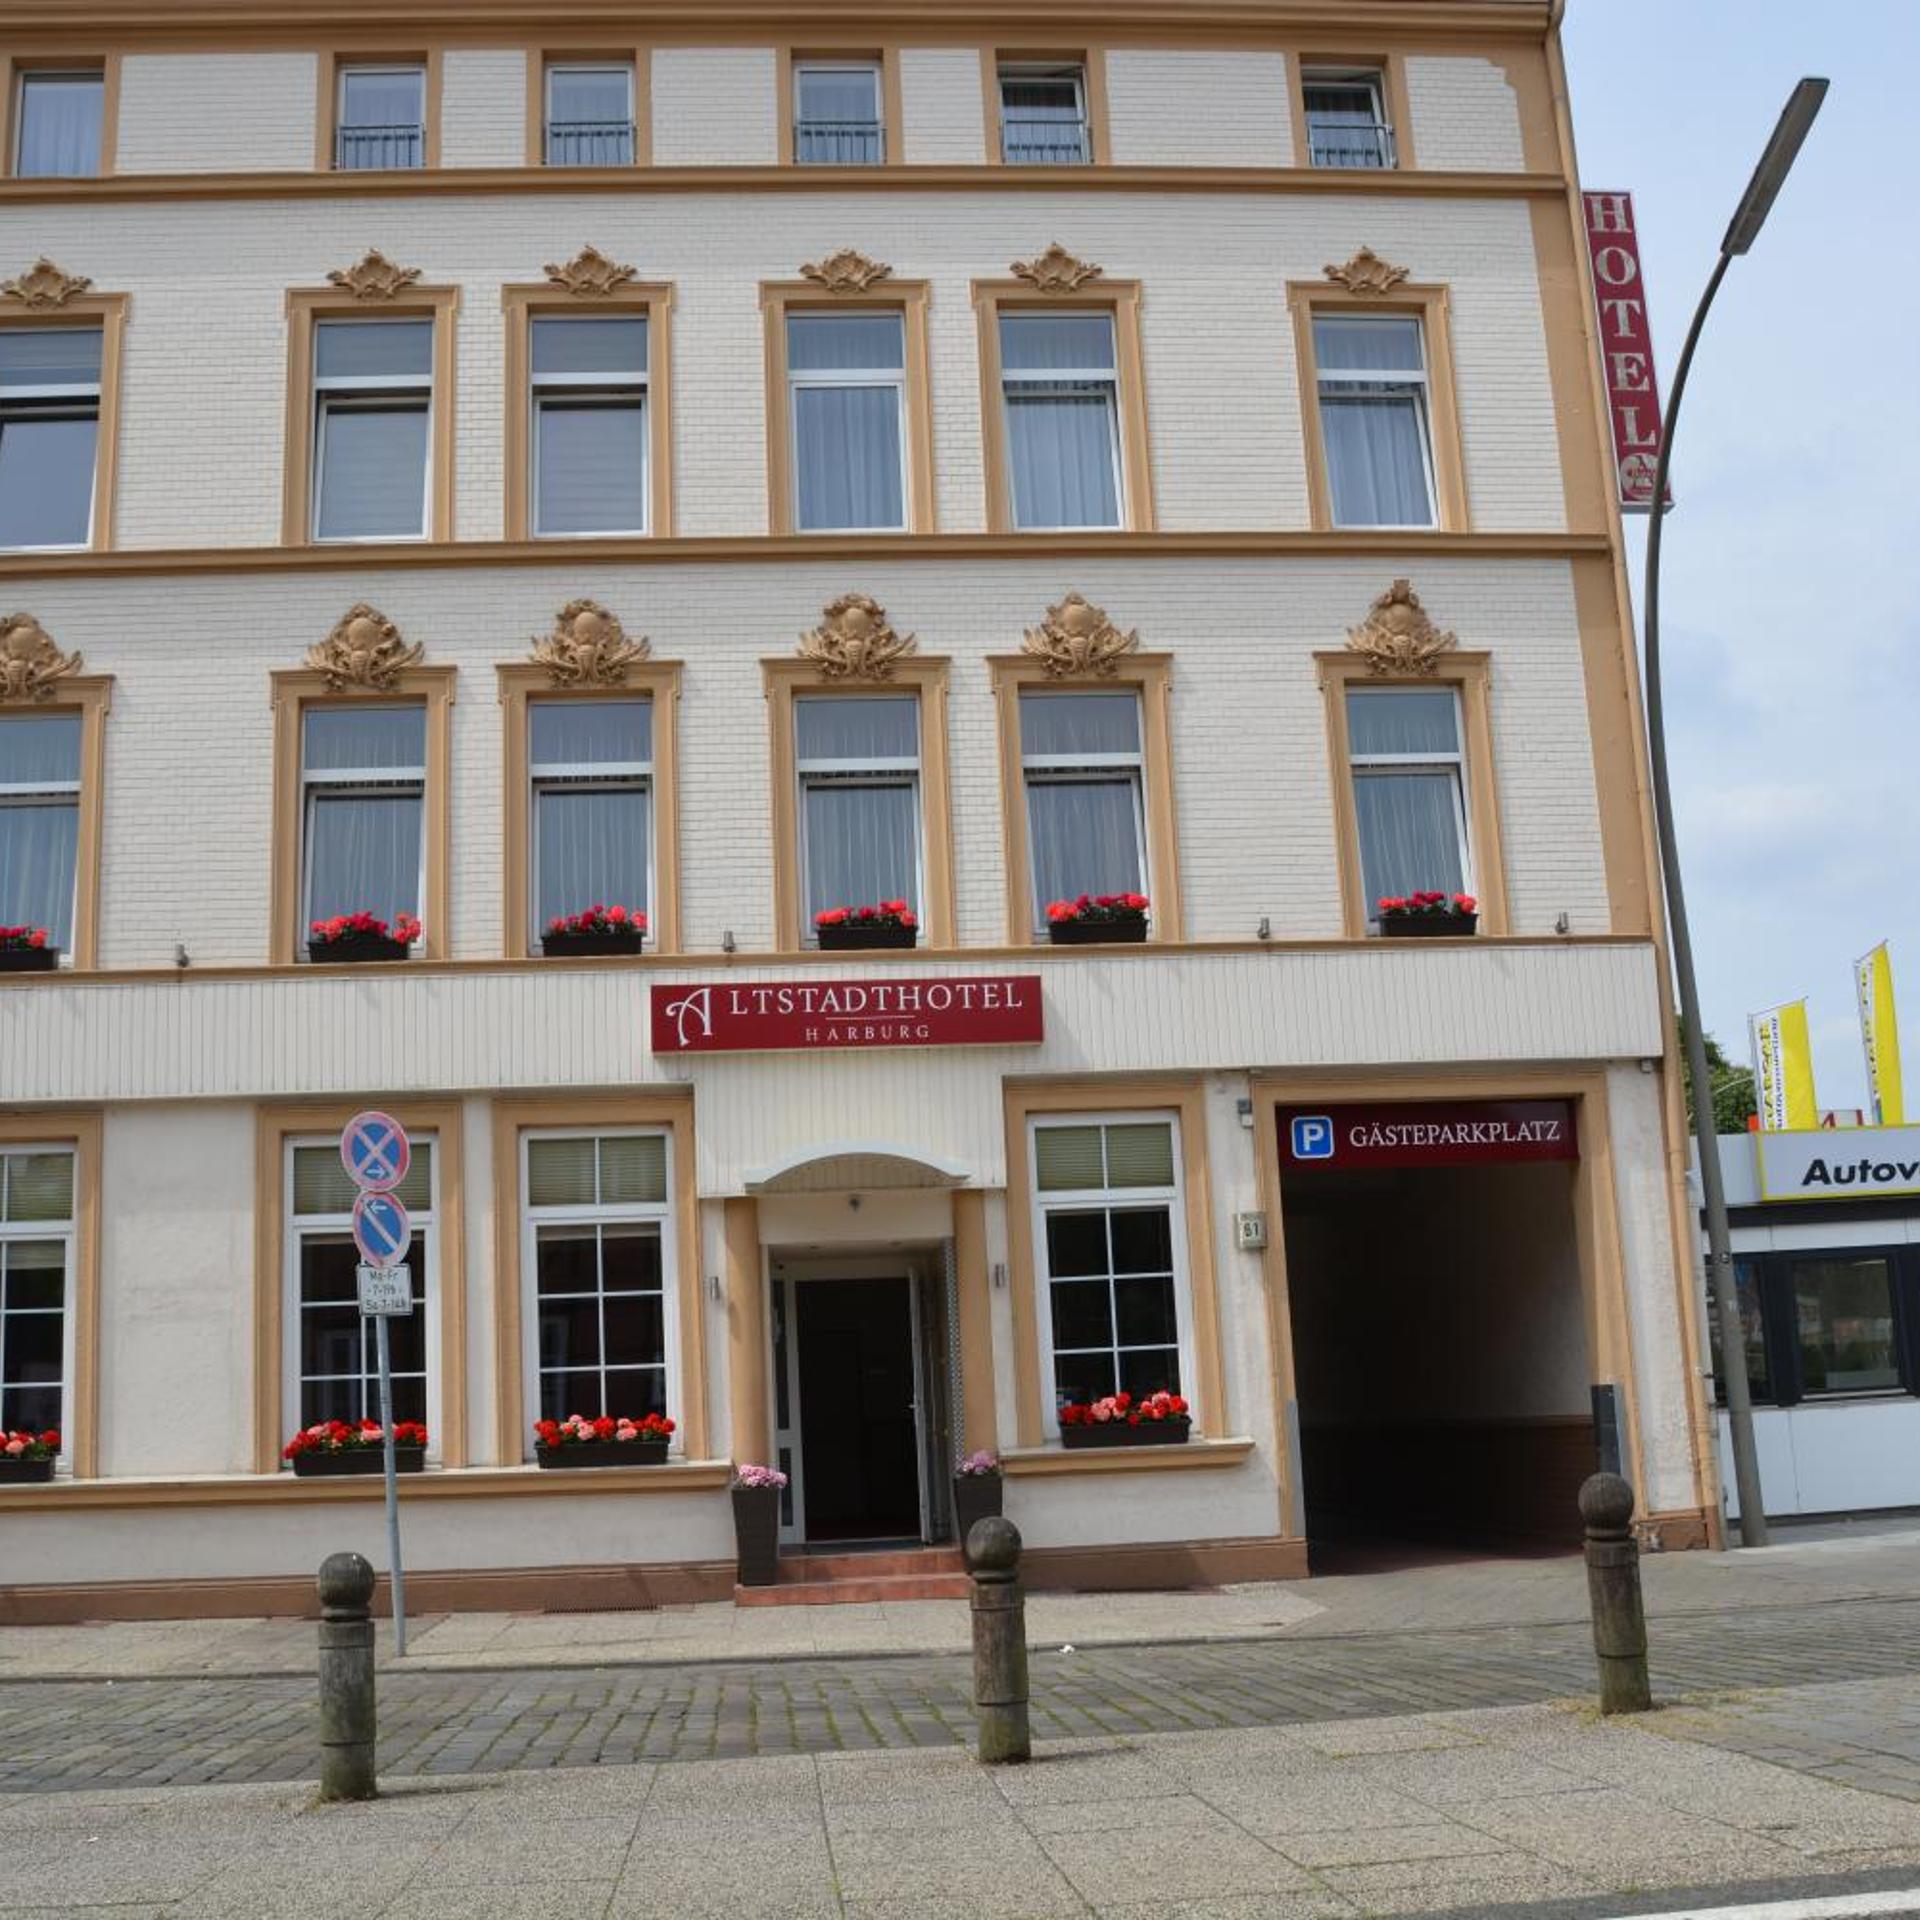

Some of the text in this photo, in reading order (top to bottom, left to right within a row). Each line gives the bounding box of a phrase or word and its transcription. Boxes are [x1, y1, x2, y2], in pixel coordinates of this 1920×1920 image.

[1589, 195, 1656, 446] HOTEL
[806, 1024, 930, 1042] HARBURG
[1349, 1121, 1560, 1147] GÄSTEPARKPLATZ
[1801, 1158, 1920, 1185] Autov
